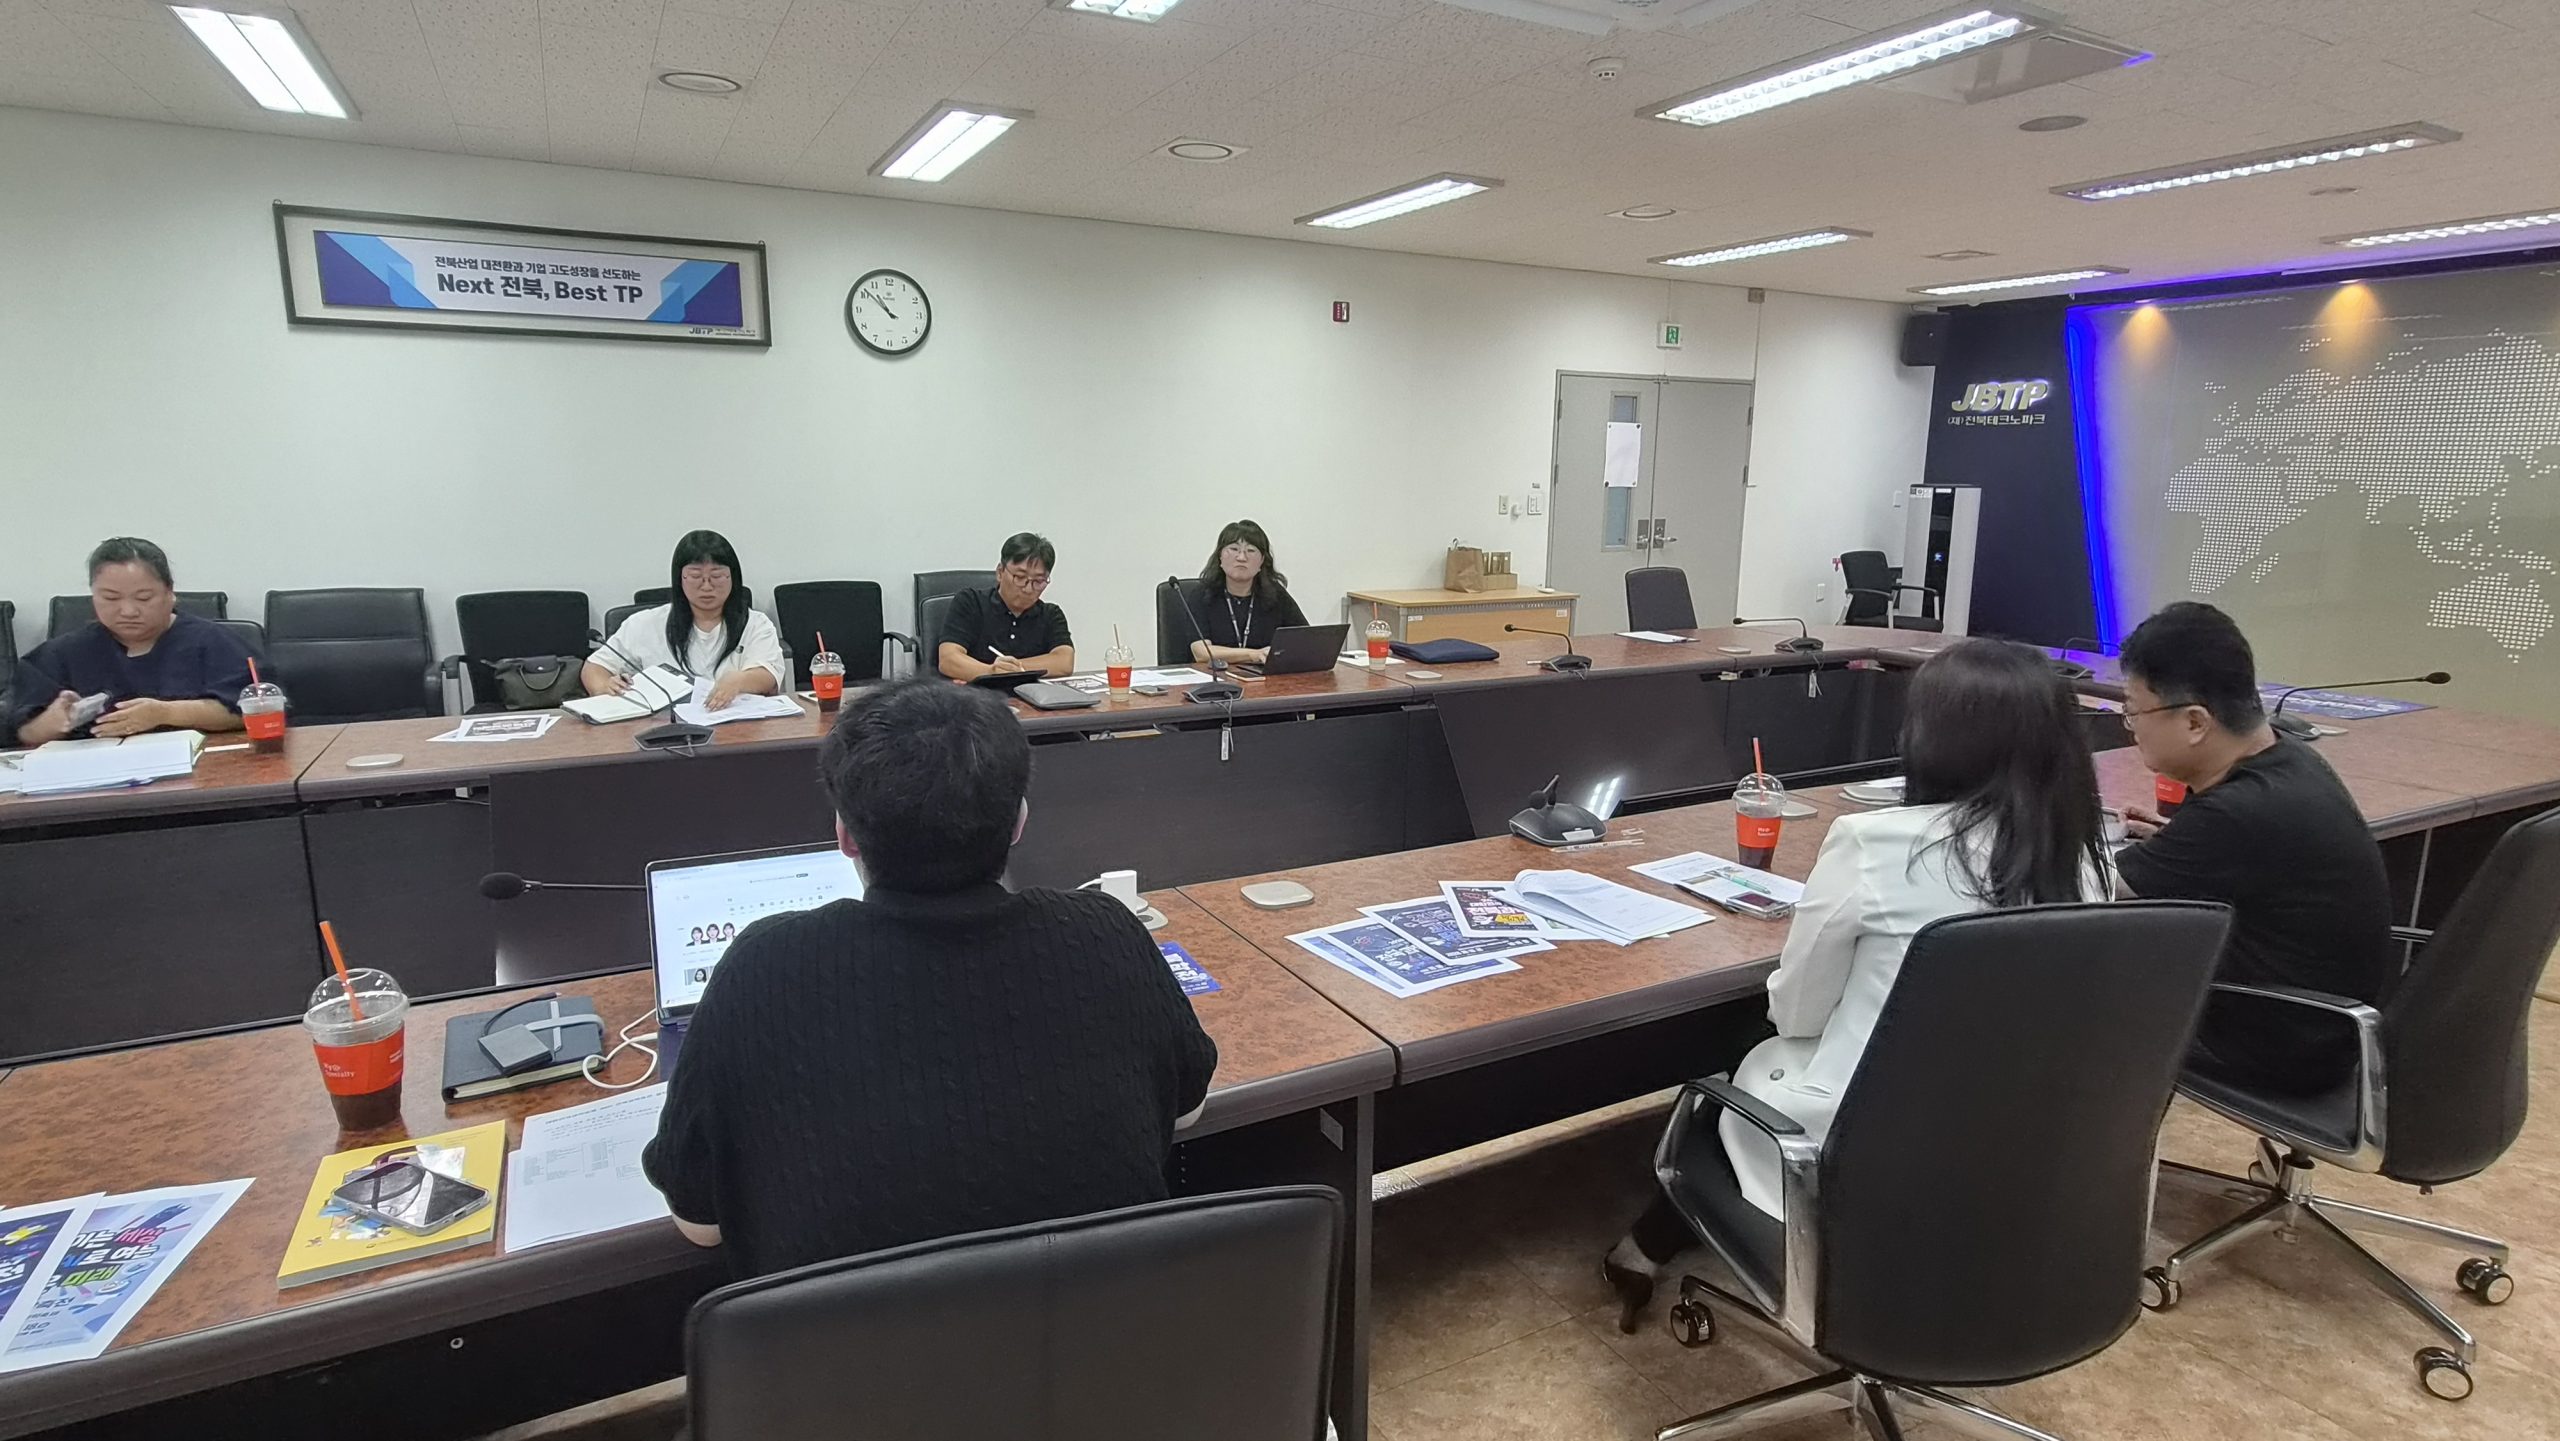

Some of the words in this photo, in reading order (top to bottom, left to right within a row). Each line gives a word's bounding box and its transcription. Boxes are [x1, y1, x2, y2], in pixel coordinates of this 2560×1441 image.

[434, 256, 478, 270] 전북산업
[481, 259, 523, 273] 대전환과
[526, 262, 546, 274] 기업
[549, 264, 600, 278] 고도성장을
[602, 268, 641, 281] 선도하는
[437, 272, 495, 295] Next
[500, 276, 550, 301] 전북,
[554, 280, 608, 302] Best
[613, 285, 643, 303] TP
[1952, 382, 2047, 411] JBTP
[64, 1266, 120, 1285] 미래
